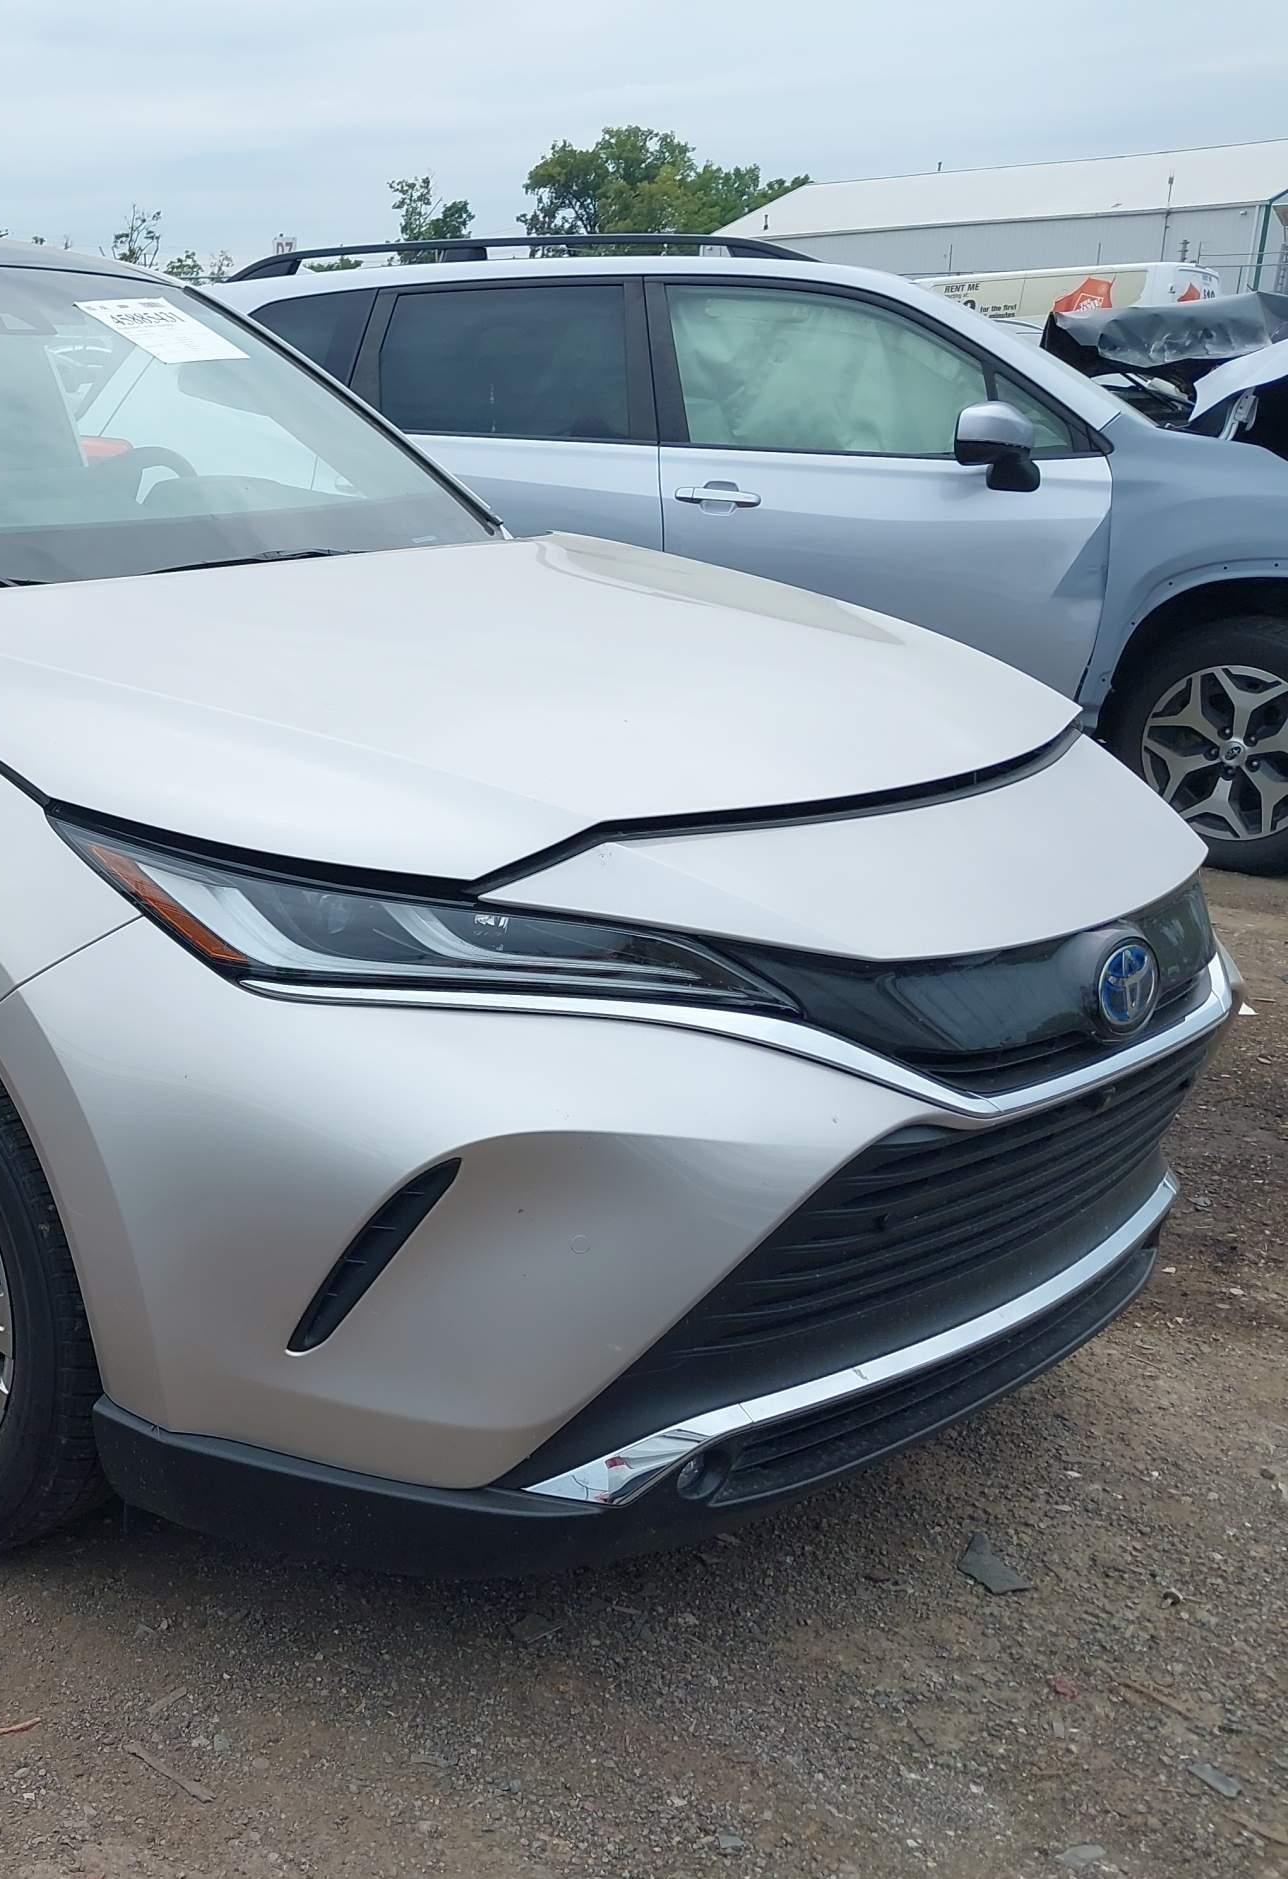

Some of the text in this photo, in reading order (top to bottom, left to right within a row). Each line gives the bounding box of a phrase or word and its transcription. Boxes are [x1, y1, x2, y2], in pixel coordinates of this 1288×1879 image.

[944, 283, 981, 293] RENT ME
[980, 305, 990, 313] for
